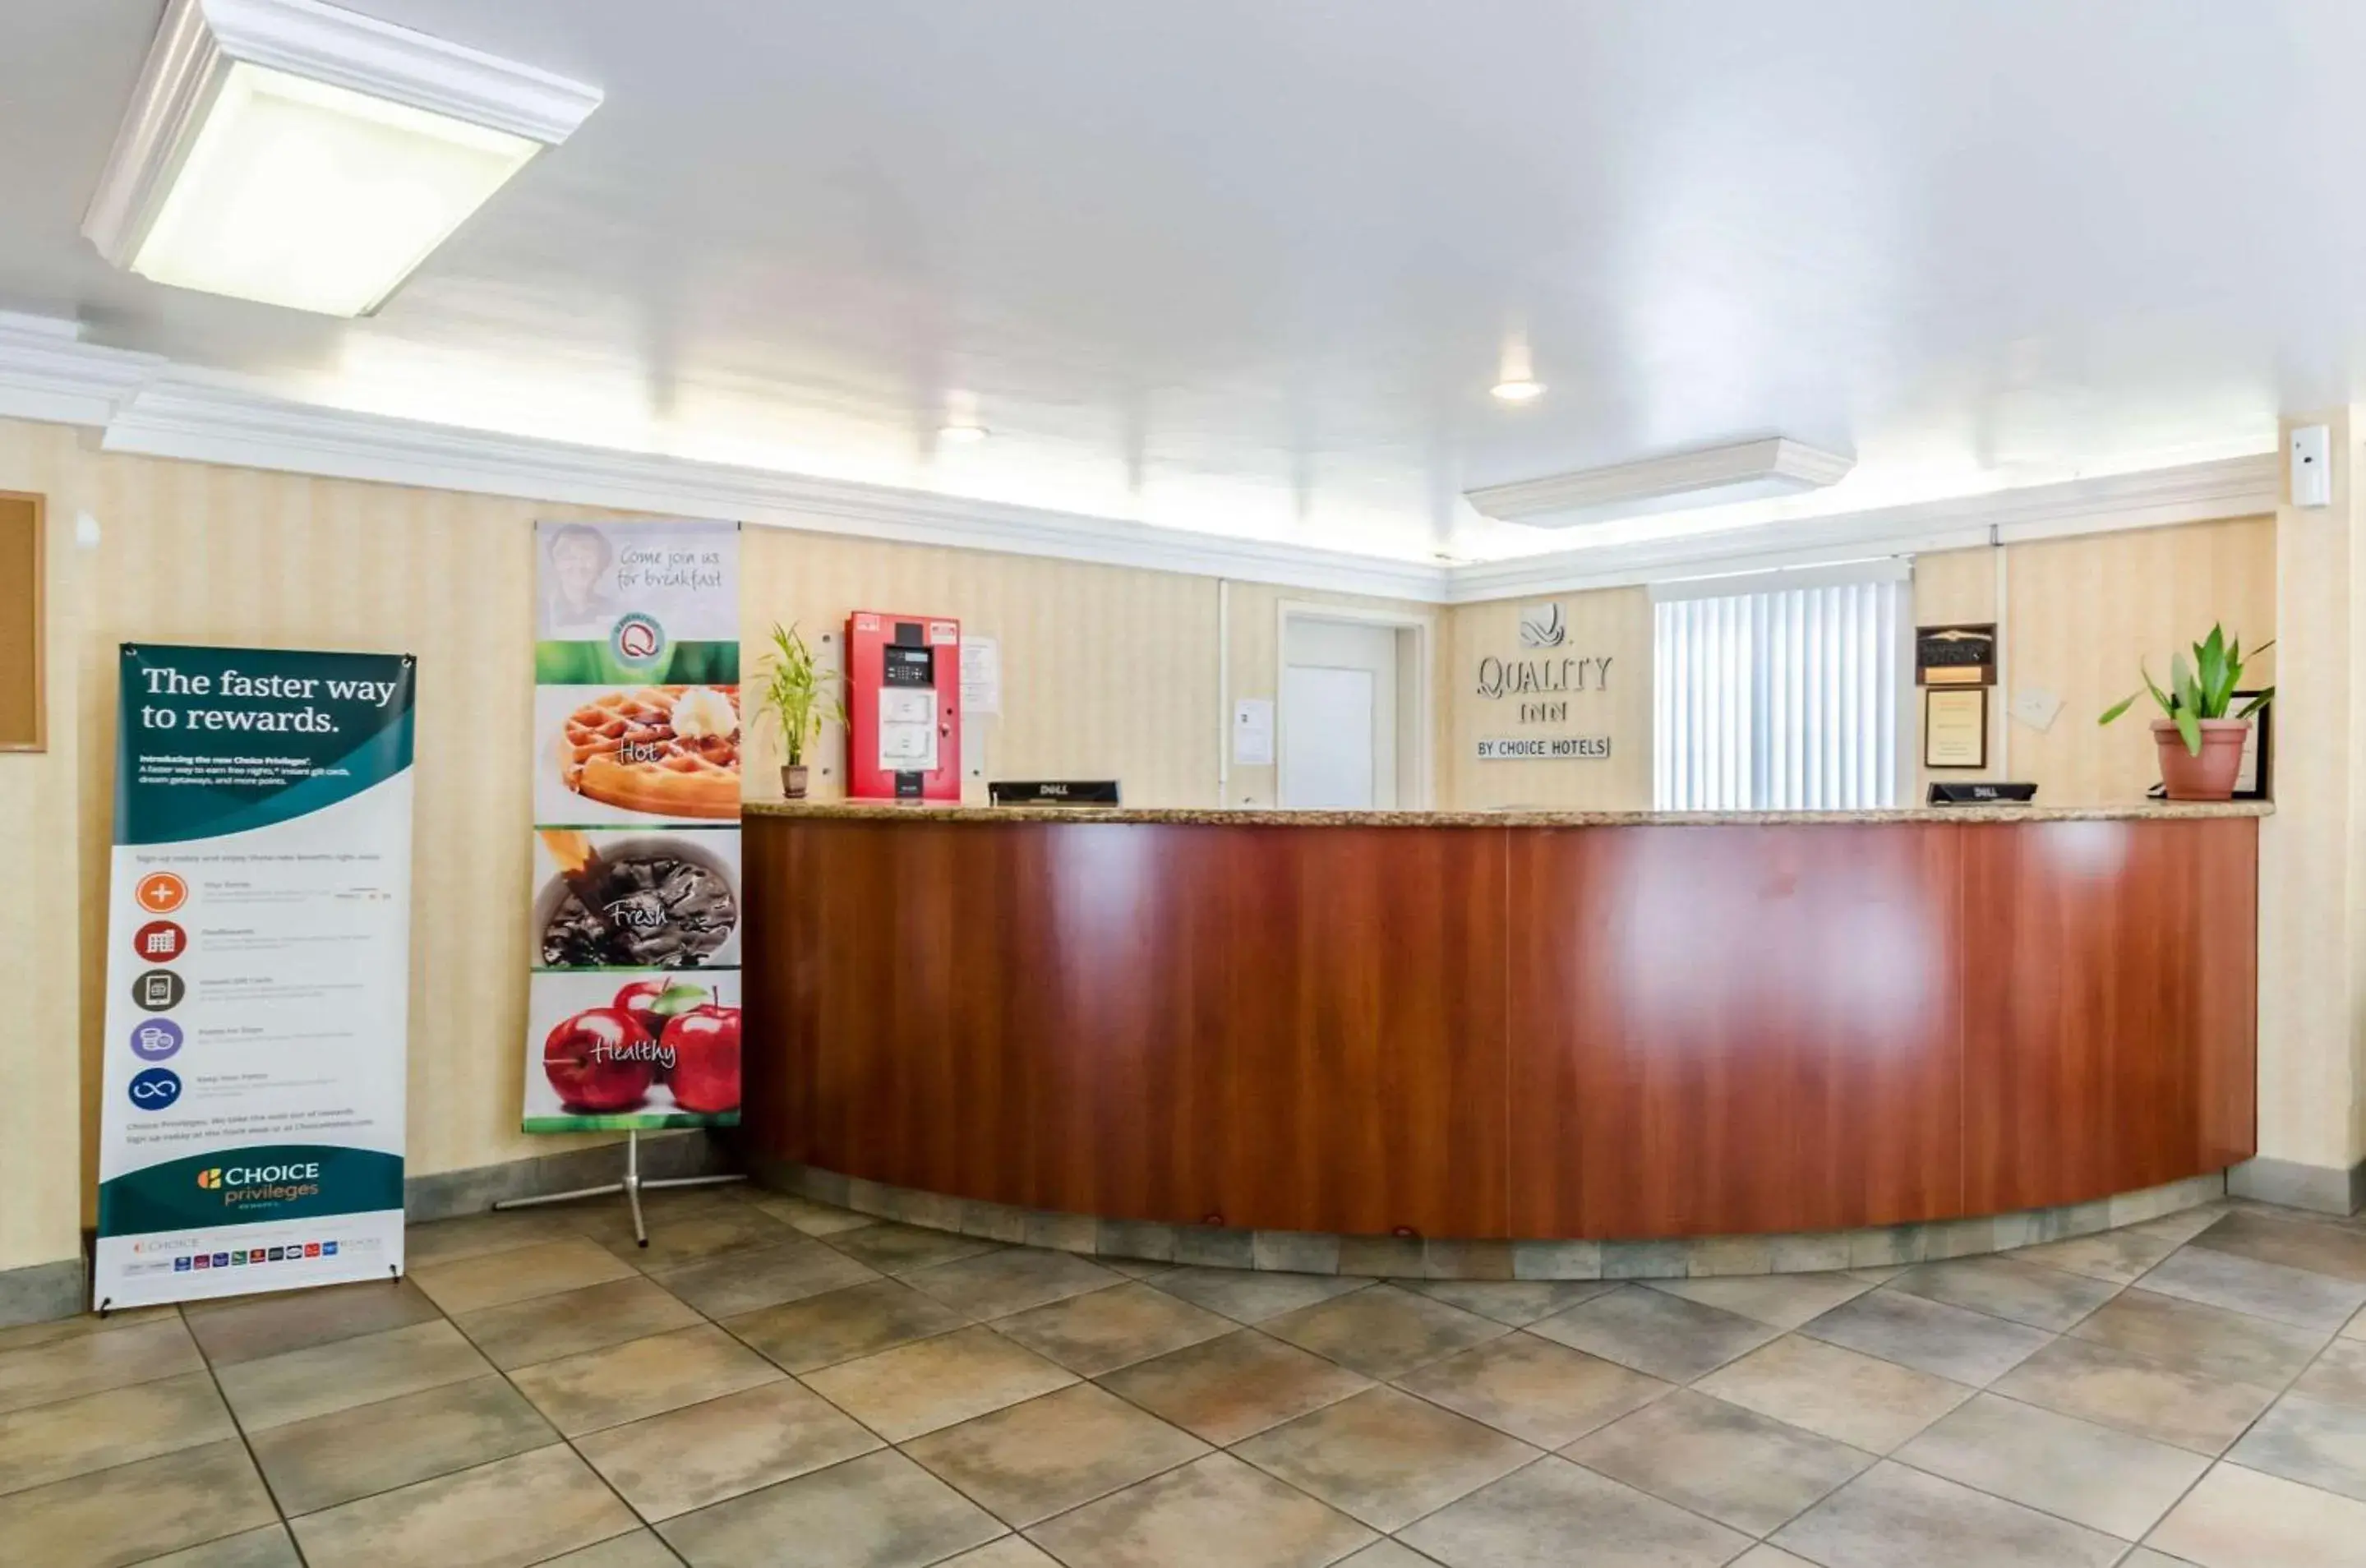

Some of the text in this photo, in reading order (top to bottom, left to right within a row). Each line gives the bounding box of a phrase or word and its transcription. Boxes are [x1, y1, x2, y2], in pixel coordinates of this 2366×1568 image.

[620, 546, 720, 568] Come join us
[617, 570, 722, 591] for breakfast
[141, 667, 397, 708] The faster way
[1477, 657, 1613, 699] QUALITY
[141, 704, 339, 733] to rewards.
[1520, 702, 1568, 724] INN
[616, 740, 658, 764] Hot
[1478, 740, 1606, 755] BY CHOICE HOTELS
[1040, 784, 1068, 795] DELL
[1974, 786, 1998, 797] DELL
[603, 899, 668, 926] Fresh
[590, 1036, 676, 1068] Healthy
[225, 1161, 320, 1186] CHOICE
[224, 1183, 319, 1207] privileges
